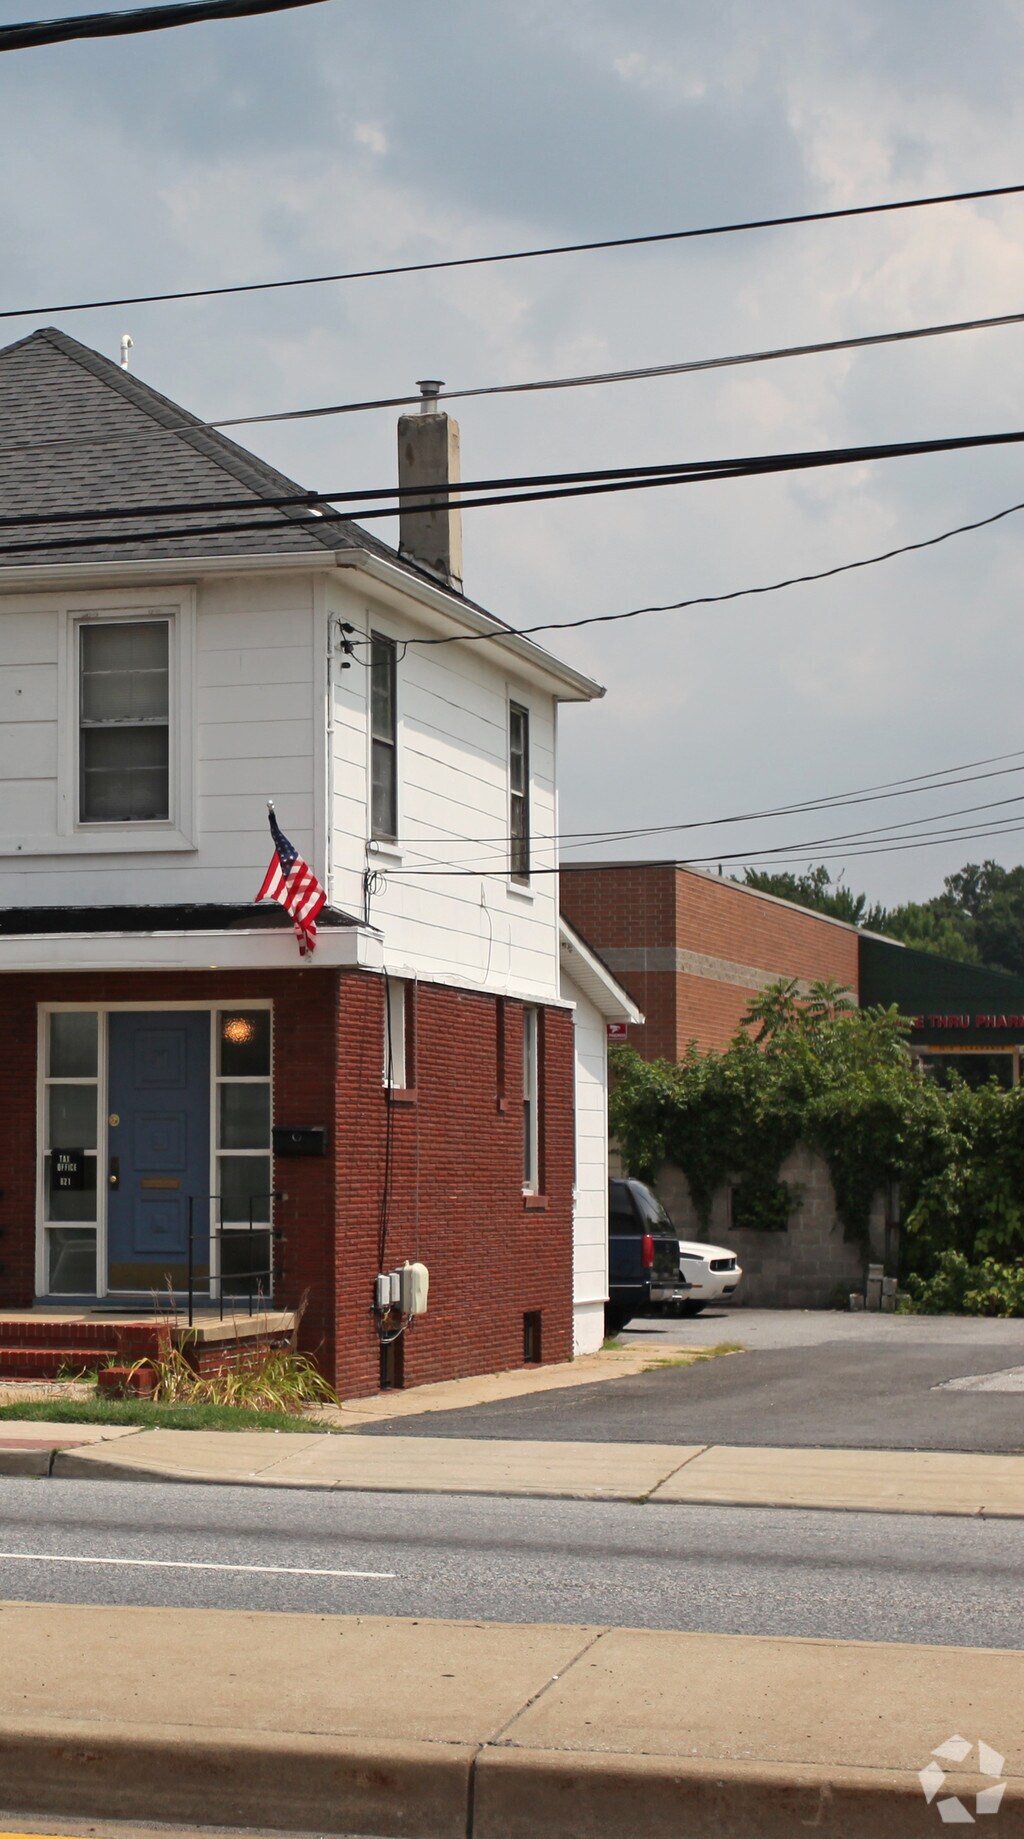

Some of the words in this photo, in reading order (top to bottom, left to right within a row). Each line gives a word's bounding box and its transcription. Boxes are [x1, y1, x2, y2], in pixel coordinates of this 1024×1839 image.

[929, 1015, 971, 1029] THRU
[59, 1154, 70, 1163] TAX
[57, 1163, 77, 1171] OFFICE
[60, 1177, 71, 1186] 821
